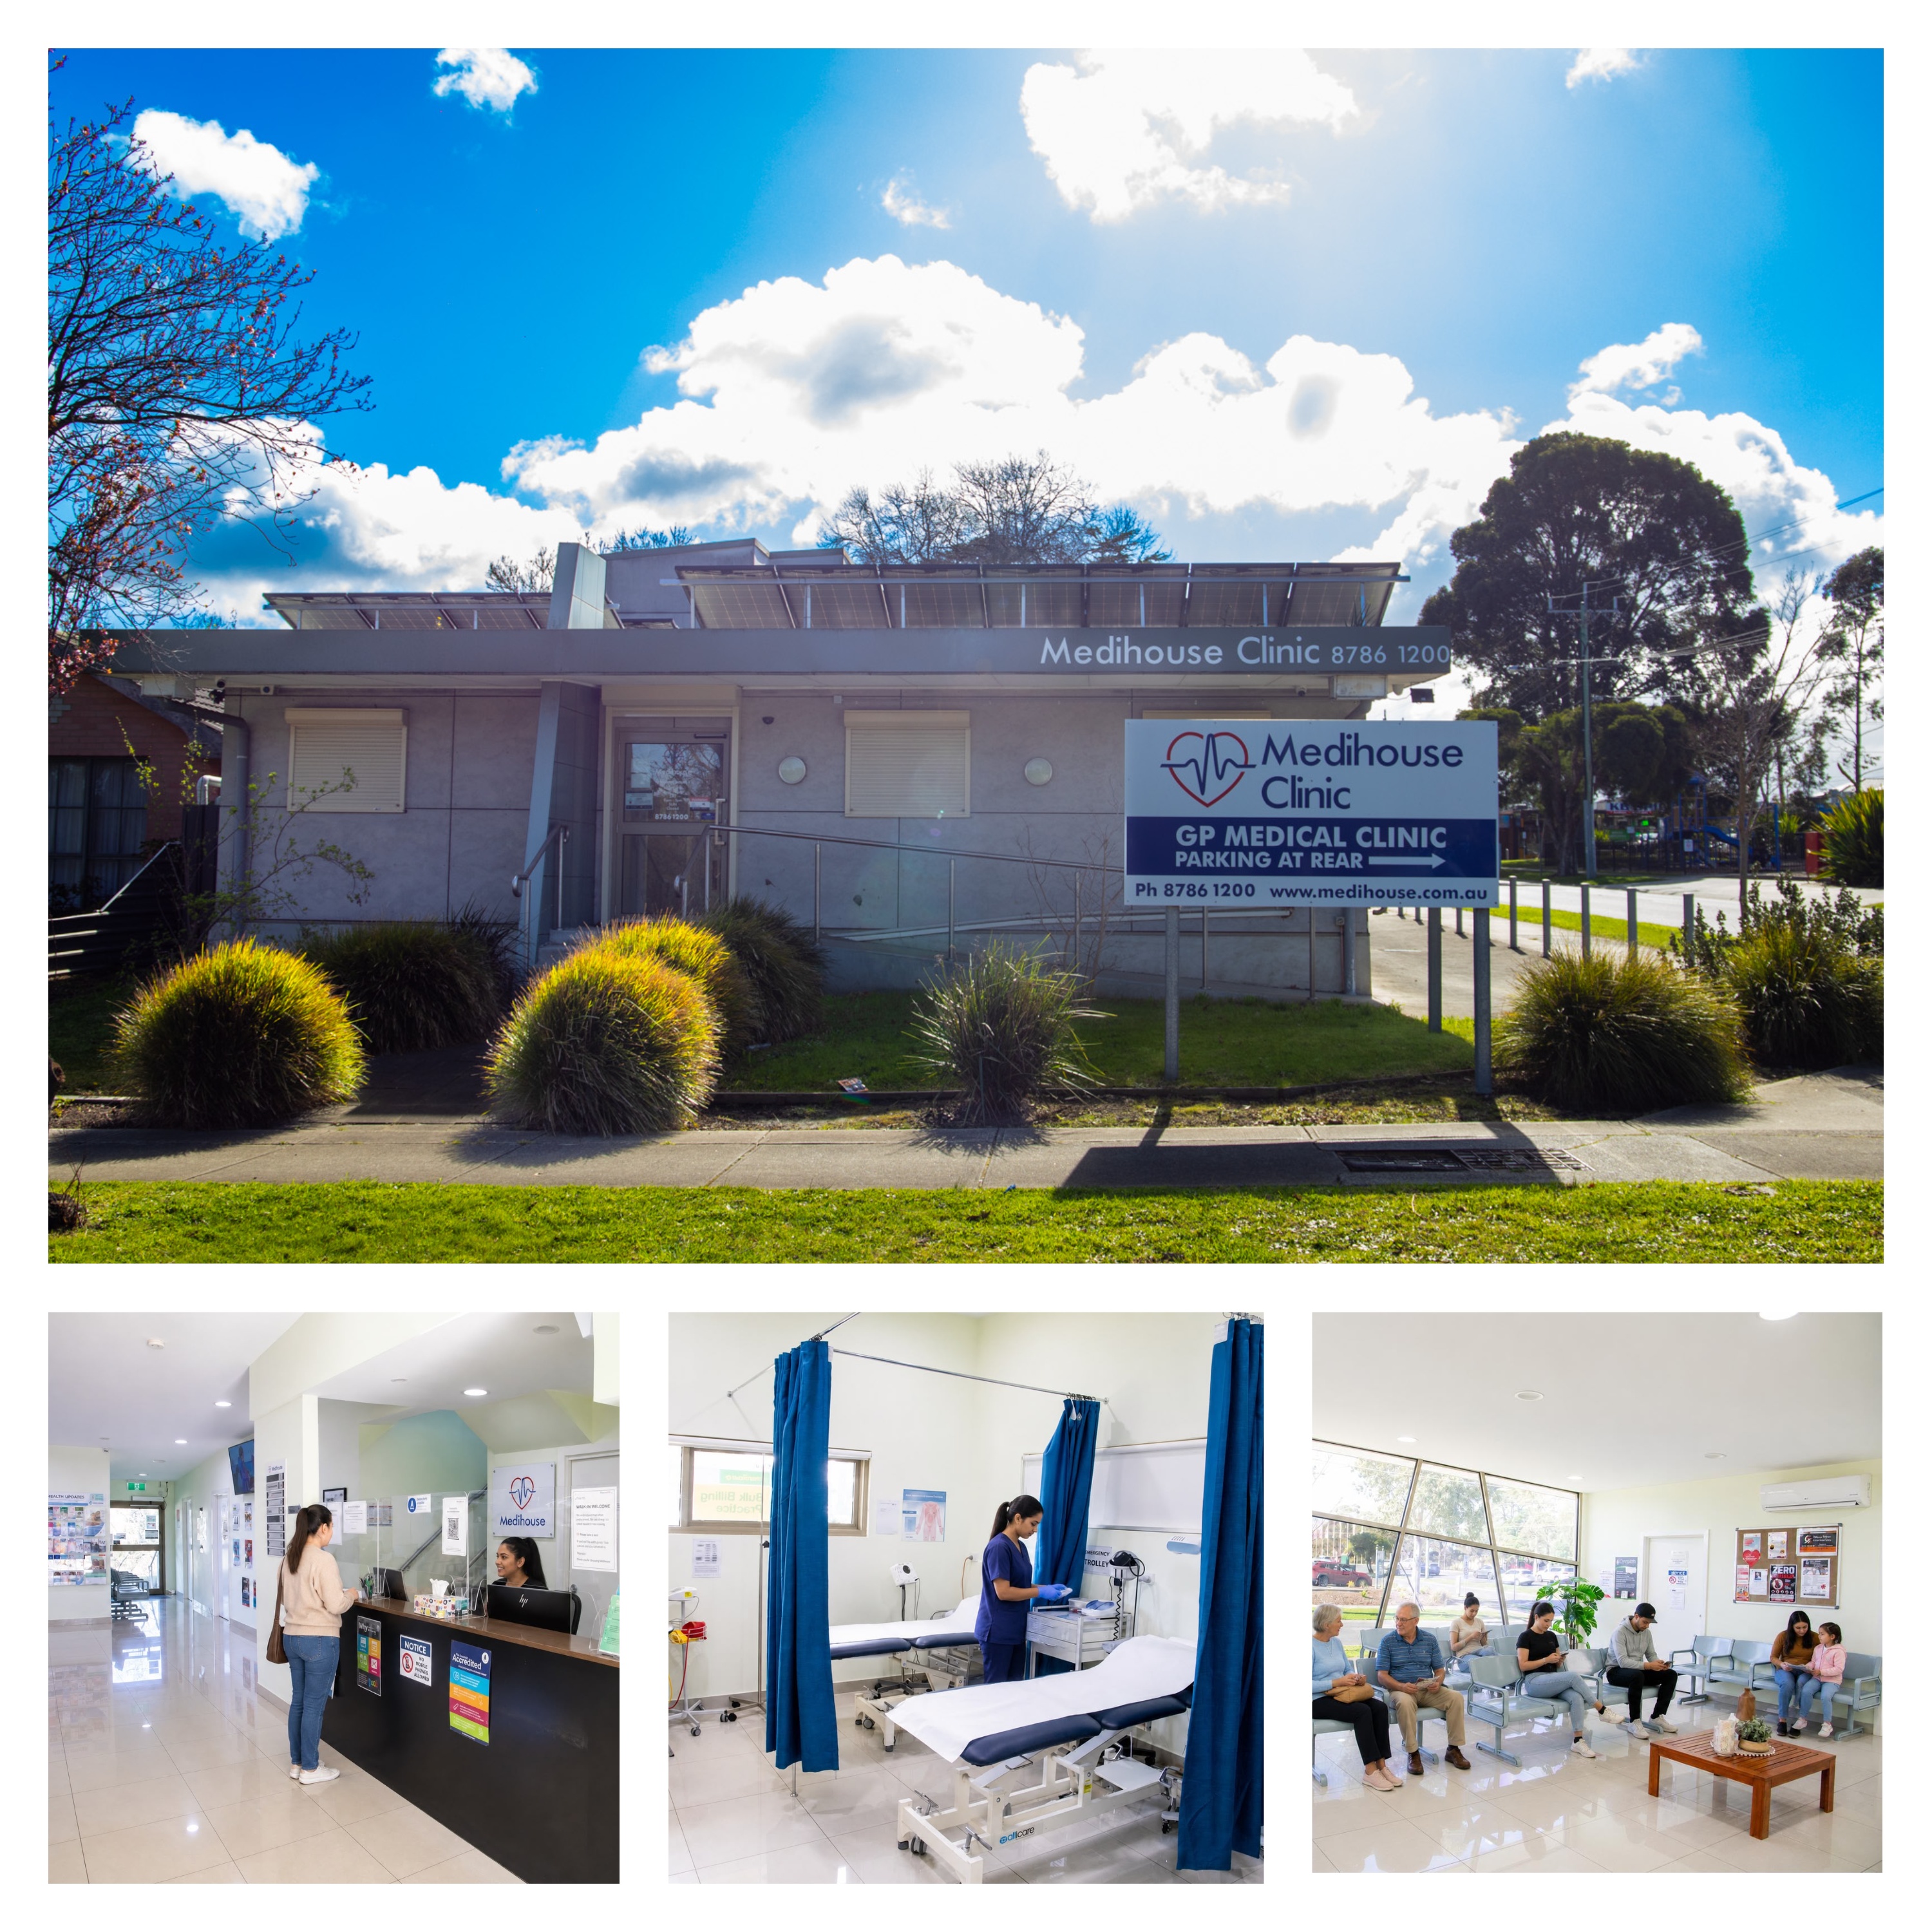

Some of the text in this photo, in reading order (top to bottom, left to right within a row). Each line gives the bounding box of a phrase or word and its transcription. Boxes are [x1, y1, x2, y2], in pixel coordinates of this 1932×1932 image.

[1040, 635, 1450, 665] Medihouse Clinic 8786 1200
[1261, 732, 1464, 768] Medihouse
[1261, 775, 1351, 810] Clinic
[1175, 825, 1447, 849] GP MEDICAL CLINIC
[1175, 851, 1363, 869] PARKING AT REAR
[1135, 883, 1488, 900] Ph 8786 1200 www.medihouse.com.au
[500, 1514, 545, 1526] Medihouse
[1084, 1558, 1109, 1567] TROLLEY
[1772, 1566, 1795, 1575] ZERO
[519, 1594, 529, 1608] hp
[404, 1640, 426, 1654] NOTICE
[452, 1654, 482, 1670] Accredited
[413, 1672, 430, 1682] ALLOWED
